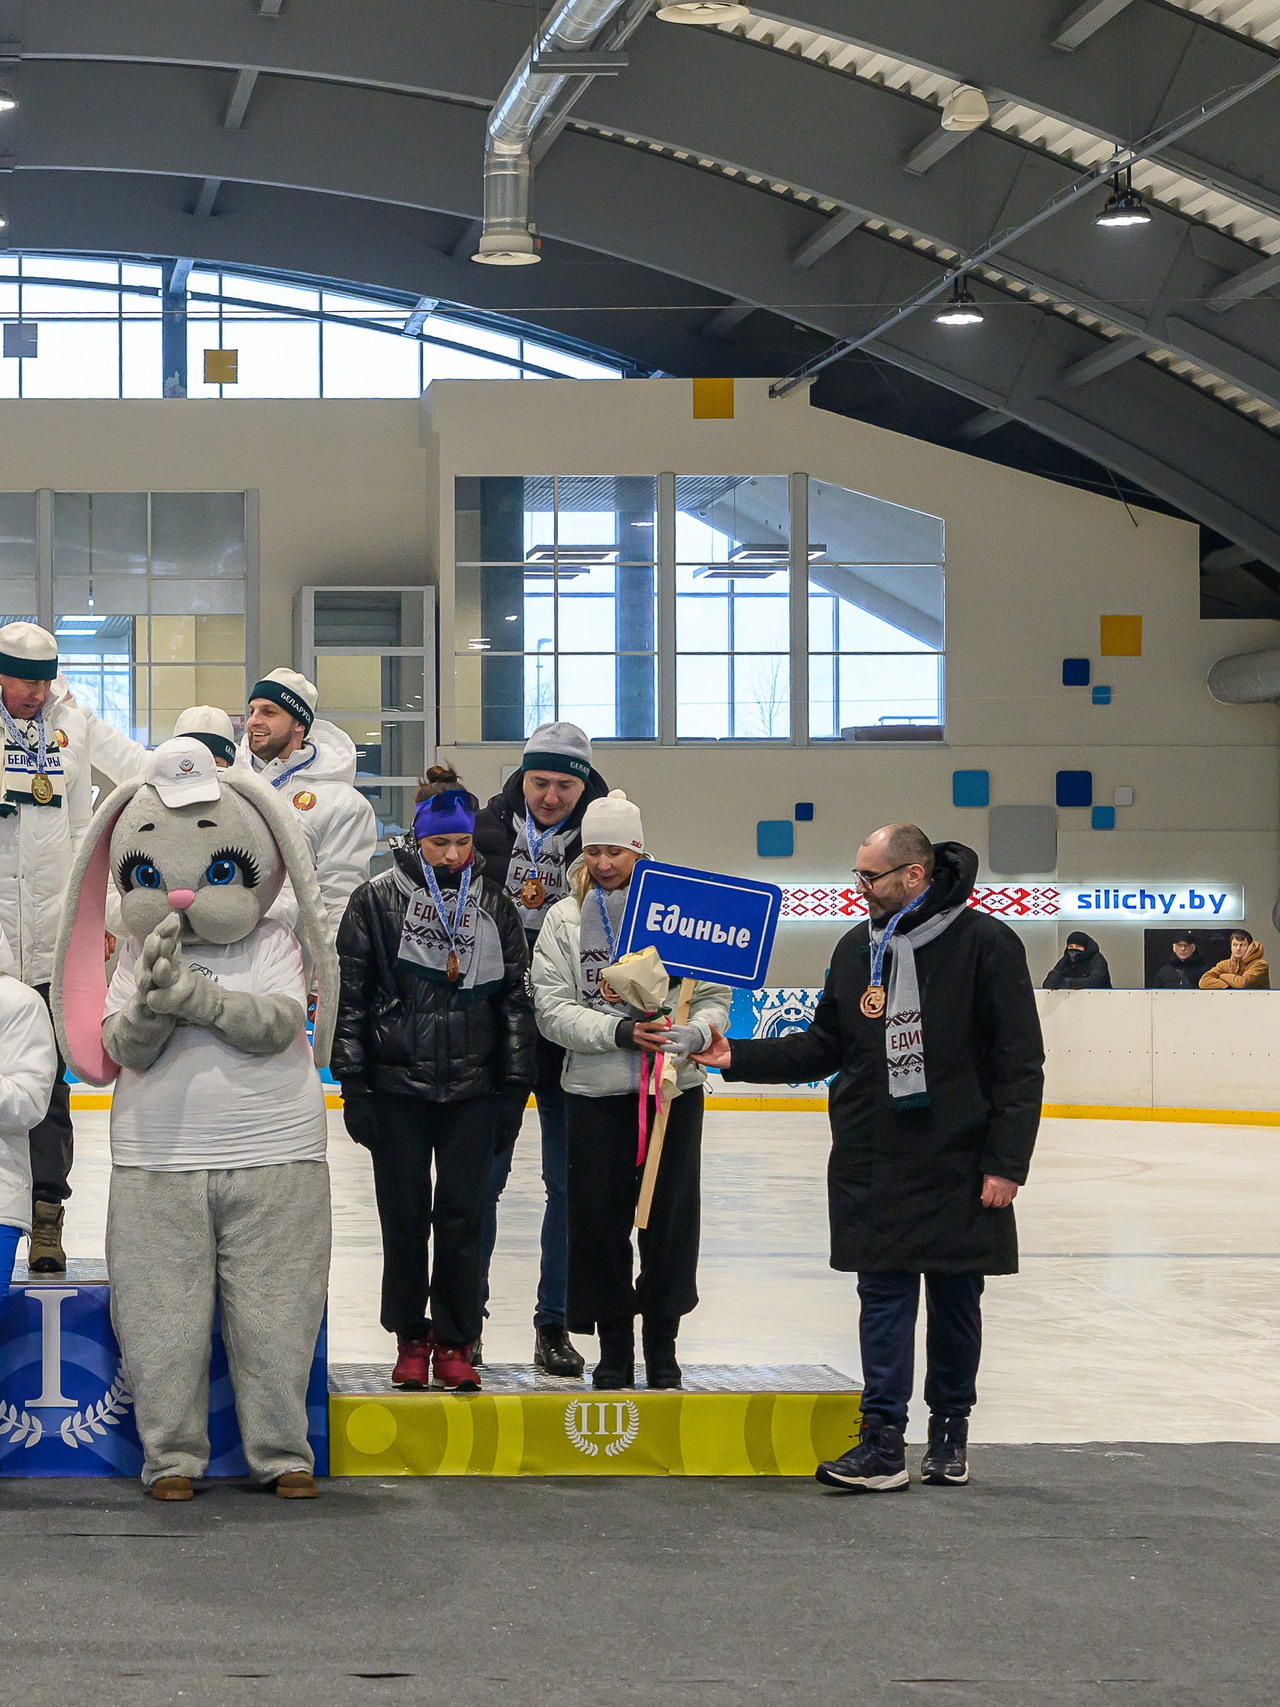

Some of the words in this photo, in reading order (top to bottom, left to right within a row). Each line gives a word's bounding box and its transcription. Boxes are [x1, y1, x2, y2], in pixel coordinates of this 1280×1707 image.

[1077, 888, 1228, 914] silichy.by
[645, 902, 752, 949] Единые
[577, 1402, 627, 1436] III
